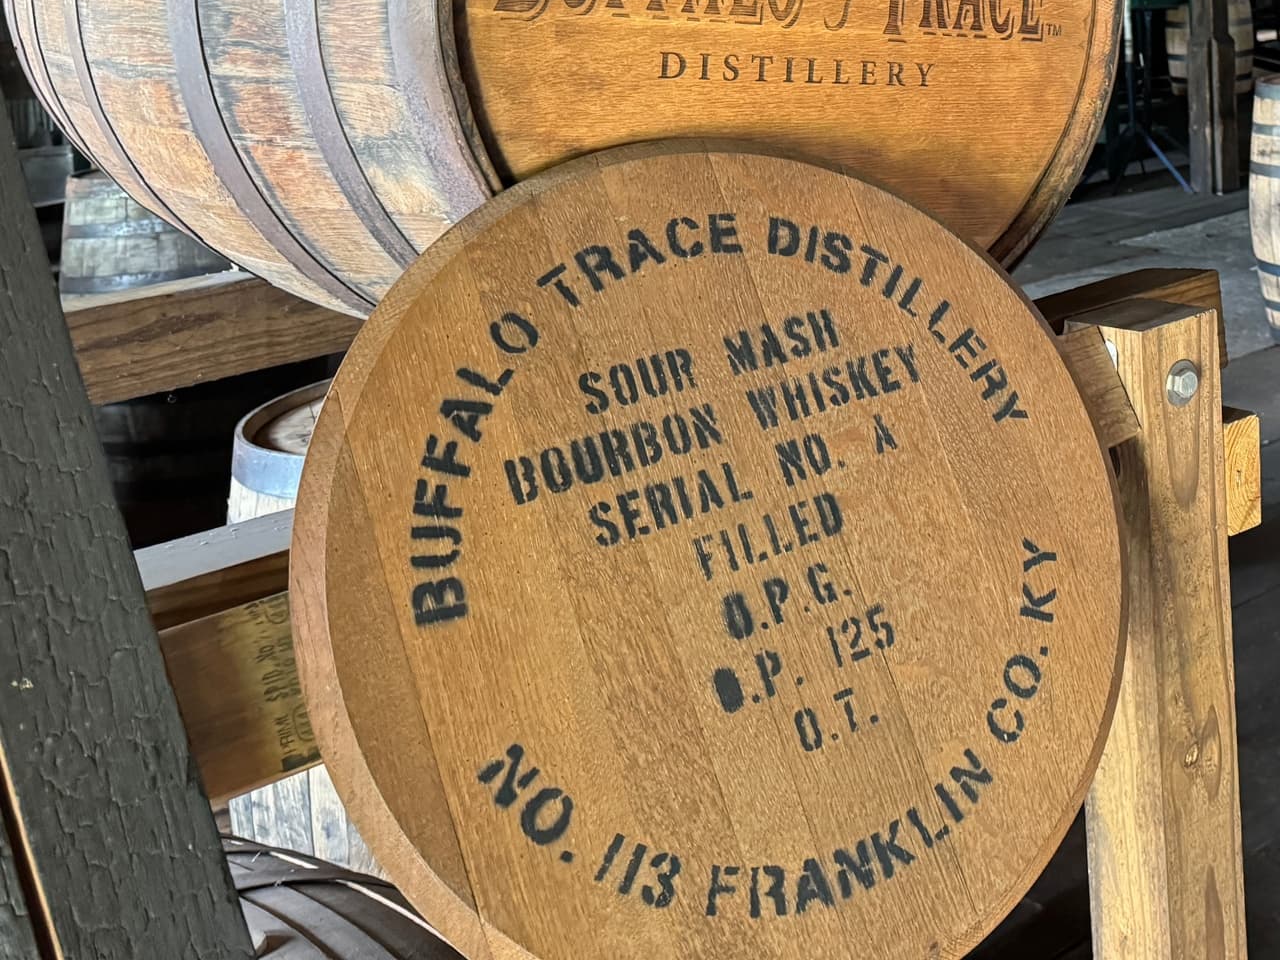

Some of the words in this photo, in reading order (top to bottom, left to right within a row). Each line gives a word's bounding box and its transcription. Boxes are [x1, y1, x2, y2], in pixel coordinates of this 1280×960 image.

[657, 50, 937, 88] DISTILLERY
[578, 348, 696, 417] SOUR
[723, 310, 840, 378] MASH
[411, 311, 540, 627] BUFFALO
[536, 212, 744, 309] TRACE
[767, 216, 1029, 426] DISTILLERY
[503, 402, 723, 507] BOURBON
[745, 342, 923, 430] WHISKEY
[588, 460, 754, 547] SERIAL
[774, 433, 847, 487] NO.
[873, 415, 898, 455] A
[693, 491, 844, 581] FILLED
[826, 604, 896, 668] 125
[477, 743, 575, 864] NO.
[594, 832, 683, 909] 113
[705, 748, 994, 920] FRANKLIN
[986, 645, 1049, 744] CO.
[1019, 536, 1058, 623] KY
[794, 688, 881, 752] O.T.
